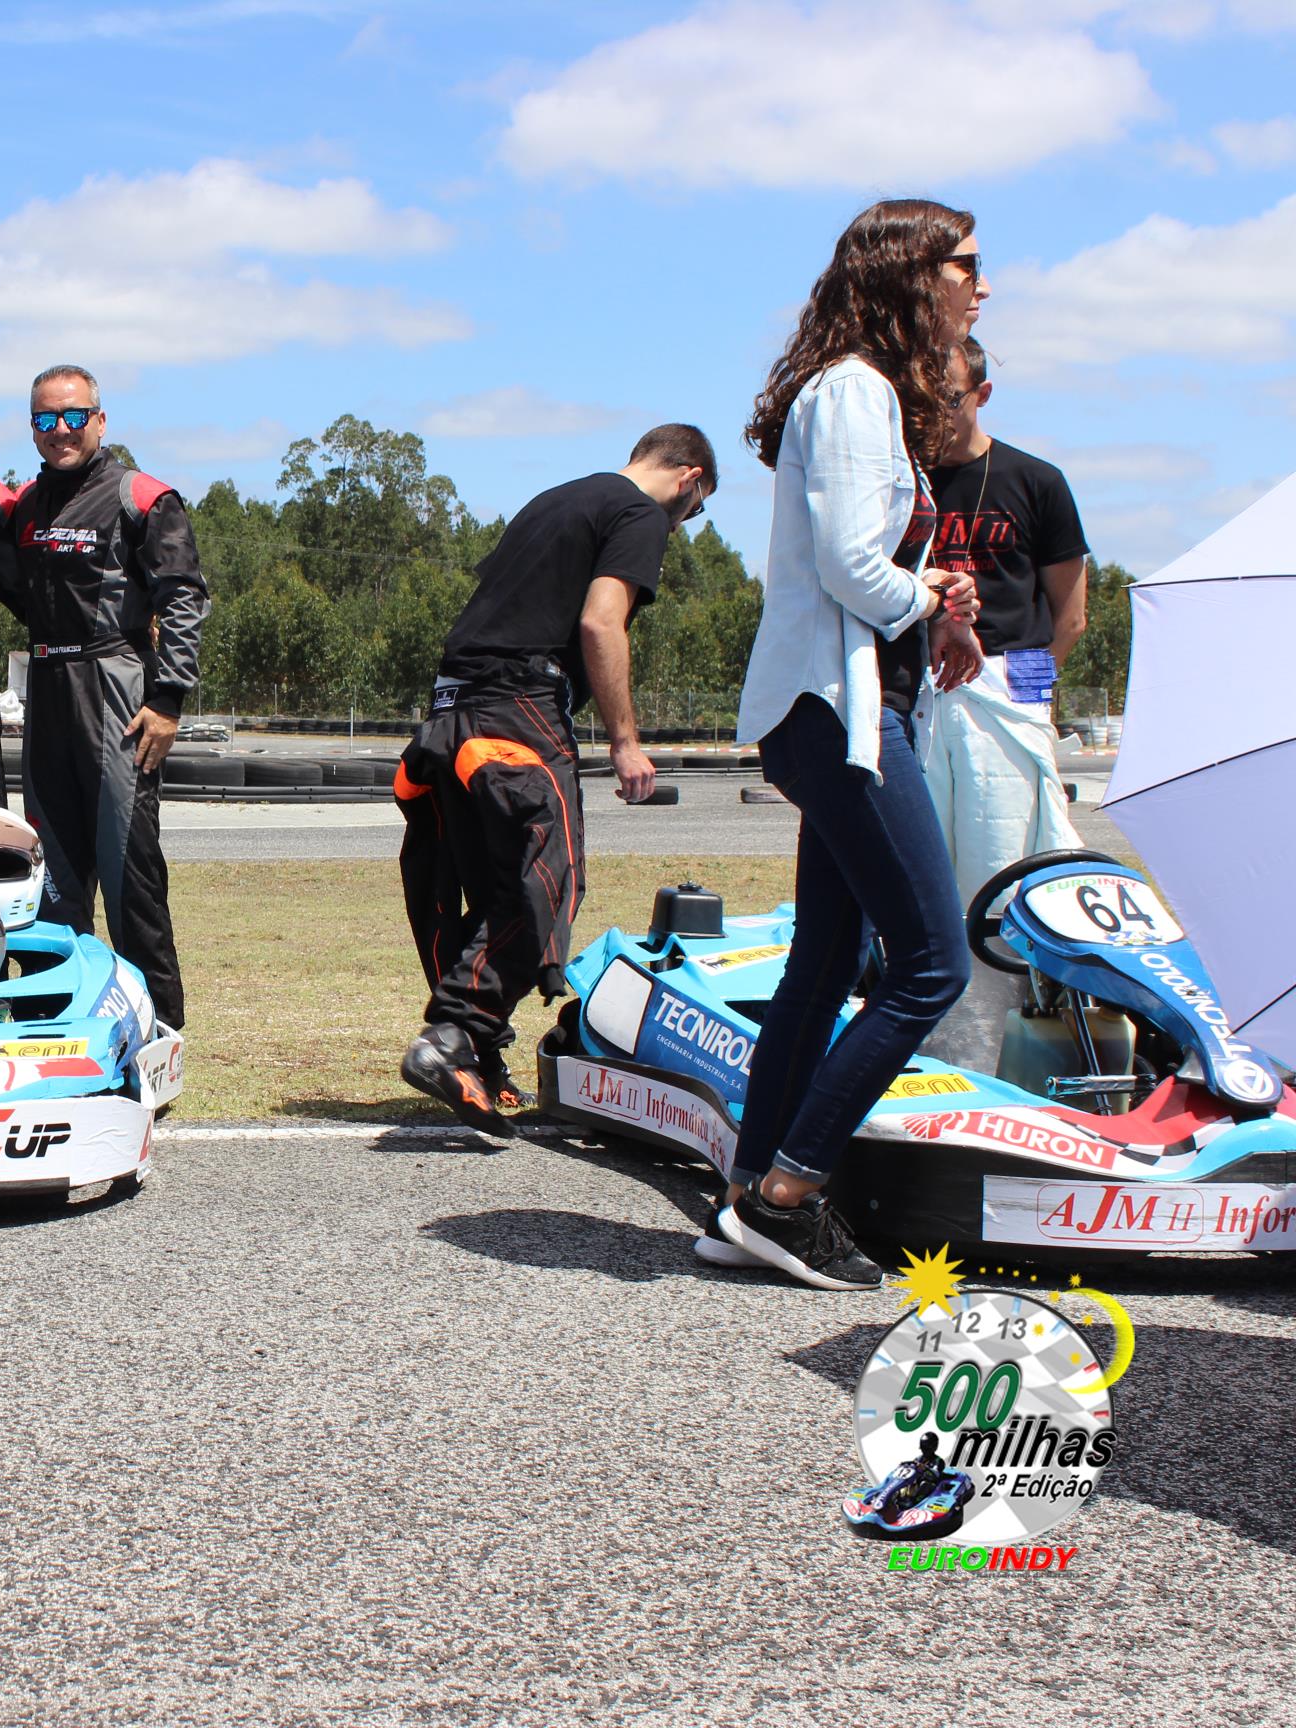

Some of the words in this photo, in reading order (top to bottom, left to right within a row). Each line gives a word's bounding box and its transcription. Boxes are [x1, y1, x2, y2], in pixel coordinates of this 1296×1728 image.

[931, 512, 984, 550] JM
[1046, 877, 1137, 894] EUROINDY
[1076, 883, 1156, 932] 64
[18, 1040, 79, 1057] eni
[654, 991, 756, 1077] TECNIROL
[656, 1033, 692, 1061] ENGENHARIA
[578, 1067, 624, 1106] AJM
[627, 1088, 638, 1111] II
[645, 1087, 709, 1143] Informática
[902, 1077, 970, 1097] eni
[976, 1114, 1103, 1165] HURON
[1040, 1185, 1161, 1235] AJM
[1166, 1203, 1197, 1232] II
